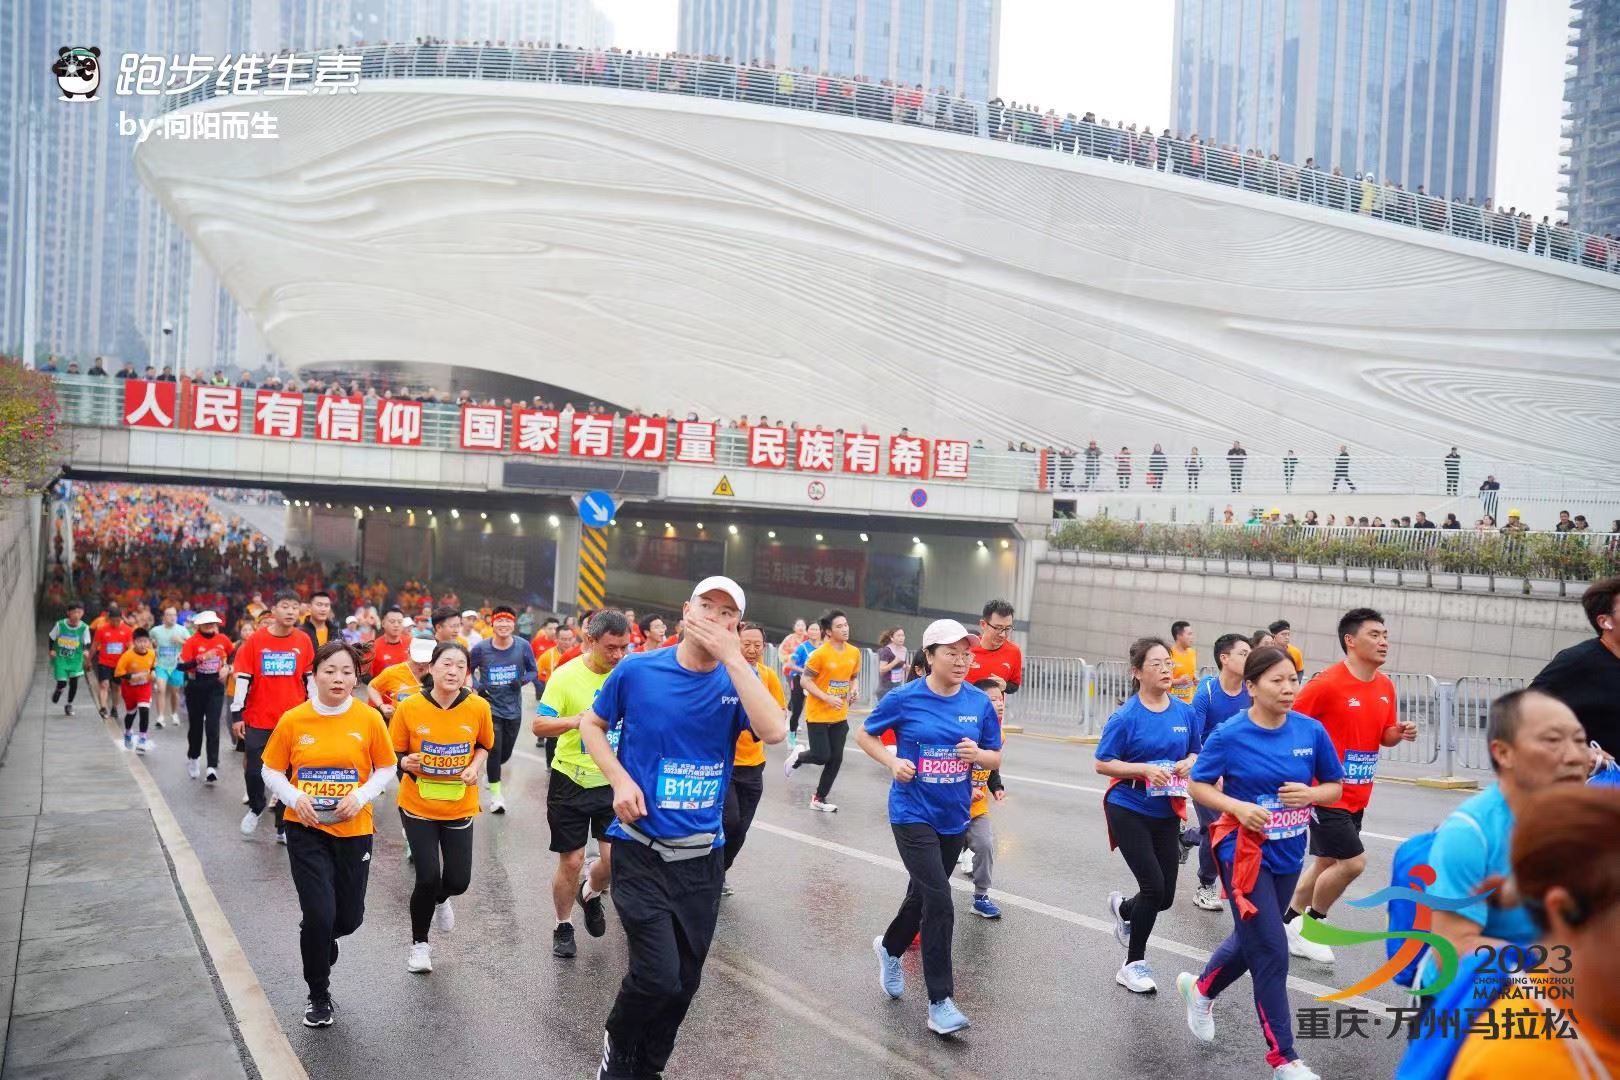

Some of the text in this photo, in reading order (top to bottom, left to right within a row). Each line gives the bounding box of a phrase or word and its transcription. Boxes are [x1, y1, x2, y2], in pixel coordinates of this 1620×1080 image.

[126, 382, 968, 479] 人民有信仰 国家有力量 民族有希望
[423, 754, 467, 769] C13033
[302, 782, 354, 797] C14522
[664, 778, 719, 797] B11472
